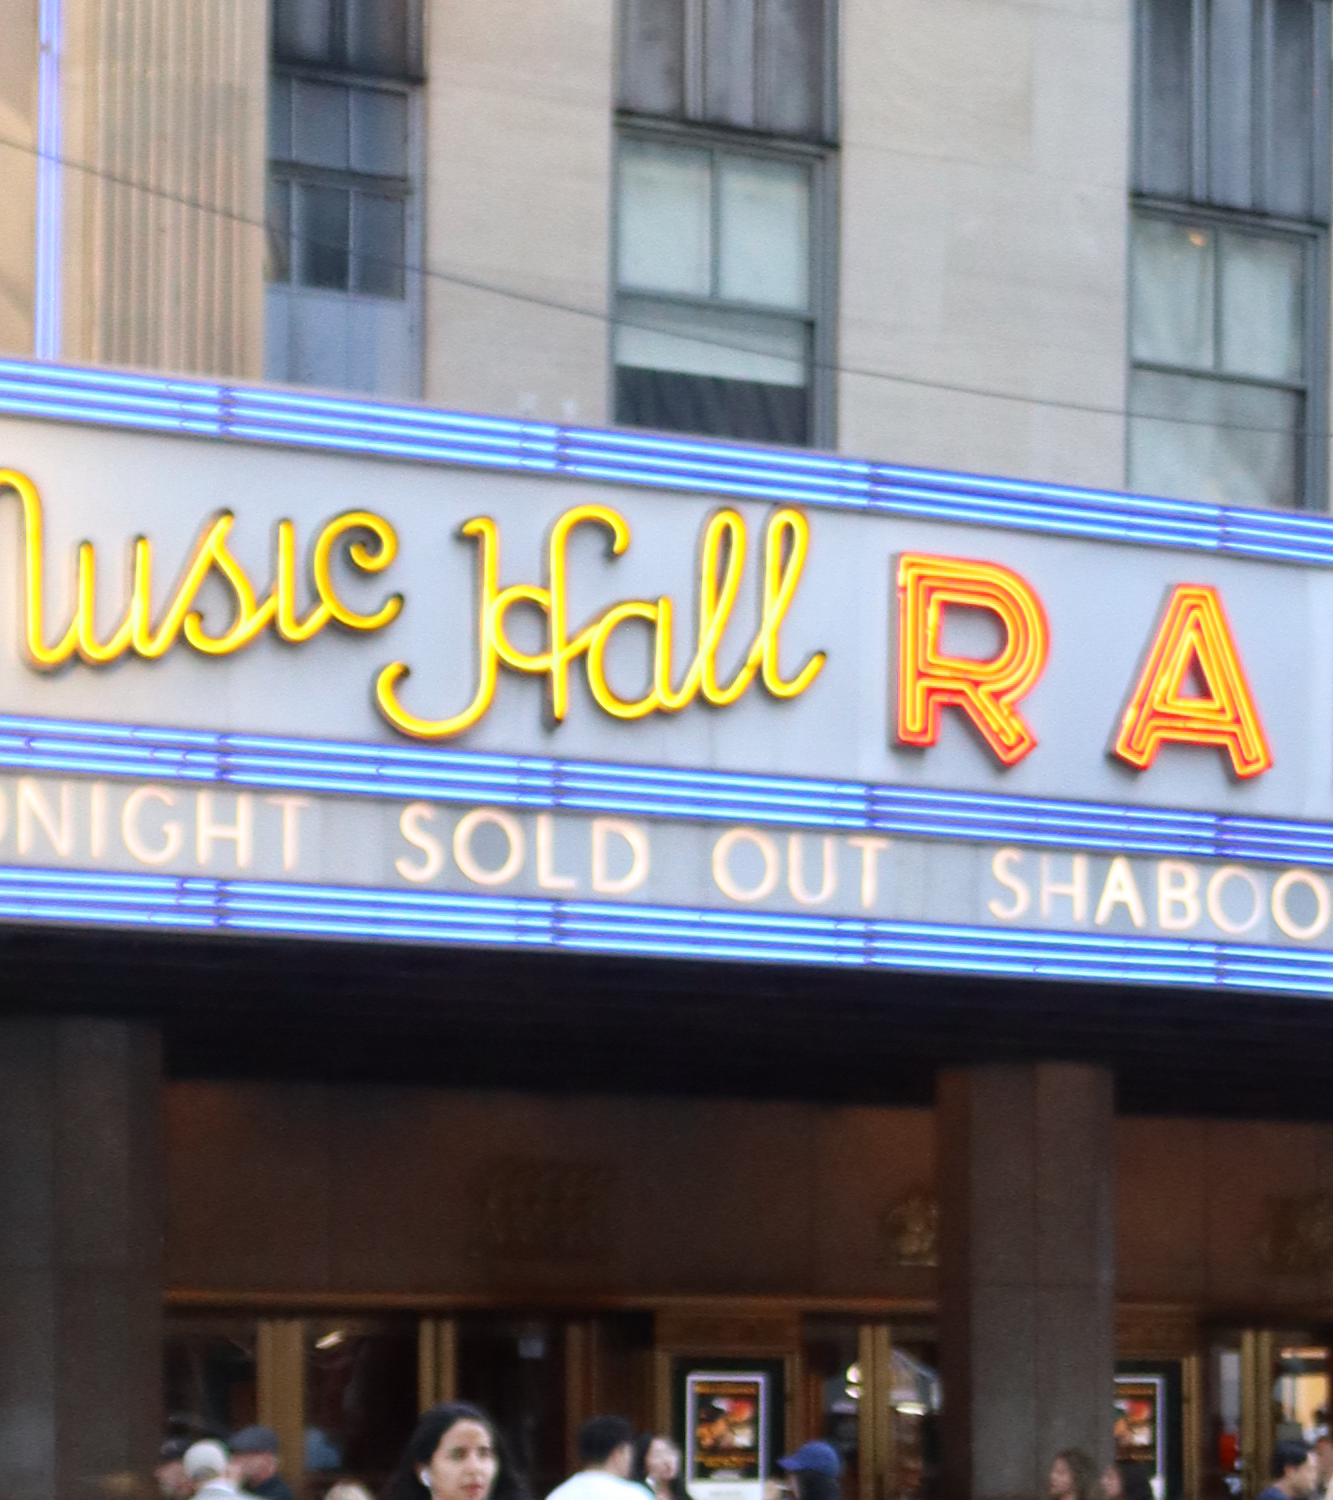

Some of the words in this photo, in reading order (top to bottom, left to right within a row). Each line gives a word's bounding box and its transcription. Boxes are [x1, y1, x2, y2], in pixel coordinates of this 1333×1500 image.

[376, 504, 827, 738] Hall
[0, 776, 311, 873] NIGHT
[395, 801, 651, 895] SOLD
[711, 827, 892, 908] OUT
